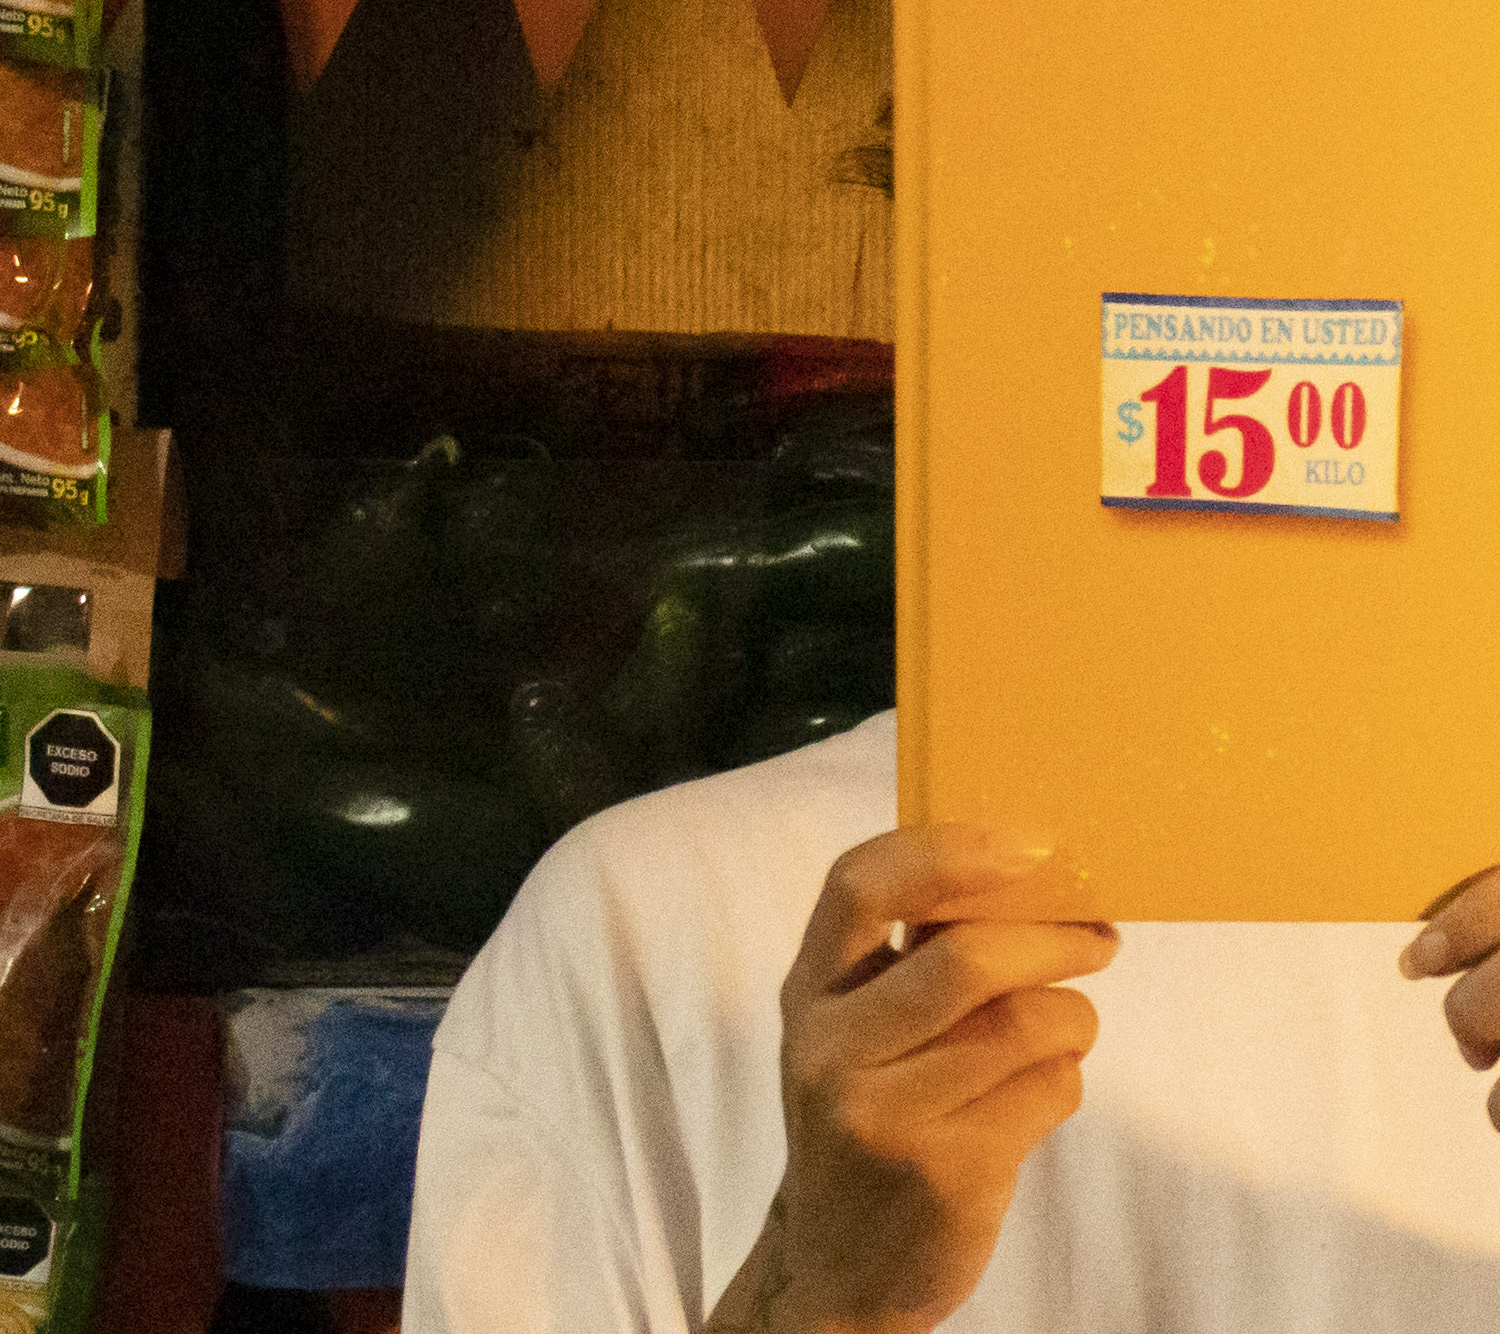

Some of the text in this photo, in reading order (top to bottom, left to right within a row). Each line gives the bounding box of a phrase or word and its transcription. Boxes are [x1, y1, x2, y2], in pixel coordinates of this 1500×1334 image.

[27, 14, 53, 37] 95
[30, 189, 55, 212] 95
[1113, 312, 1388, 347] PENSANDO EN USTED
[1304, 459, 1366, 487] KILO
[52, 479, 78, 500] 95
[46, 744, 98, 762] EXCESO
[51, 762, 90, 778] SODIO
